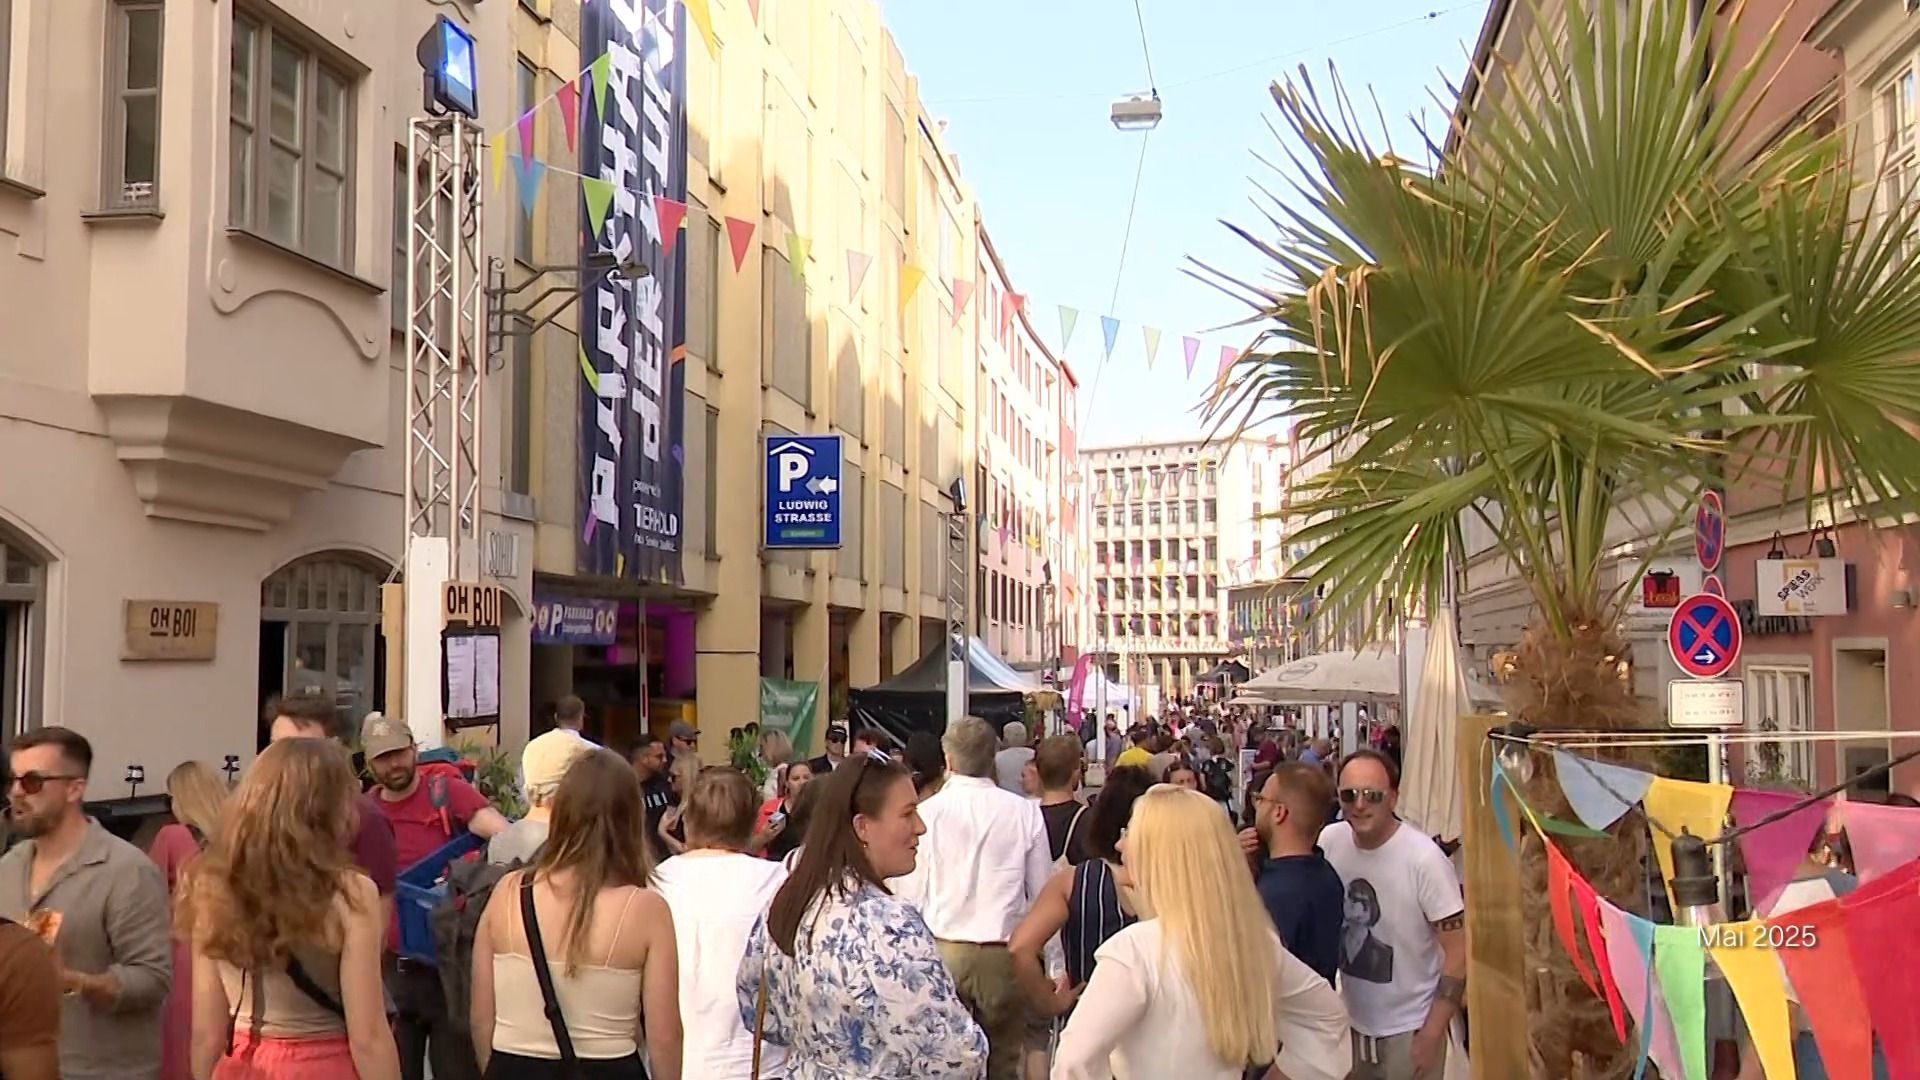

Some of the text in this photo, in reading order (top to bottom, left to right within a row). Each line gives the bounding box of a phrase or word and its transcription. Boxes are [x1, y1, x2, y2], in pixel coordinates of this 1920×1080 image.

[779, 452, 809, 493] P
[774, 513, 832, 523] STRASSE
[778, 500, 828, 510] LUDWIG
[447, 585, 498, 626] OH BOI
[150, 607, 197, 637] OH BOI
